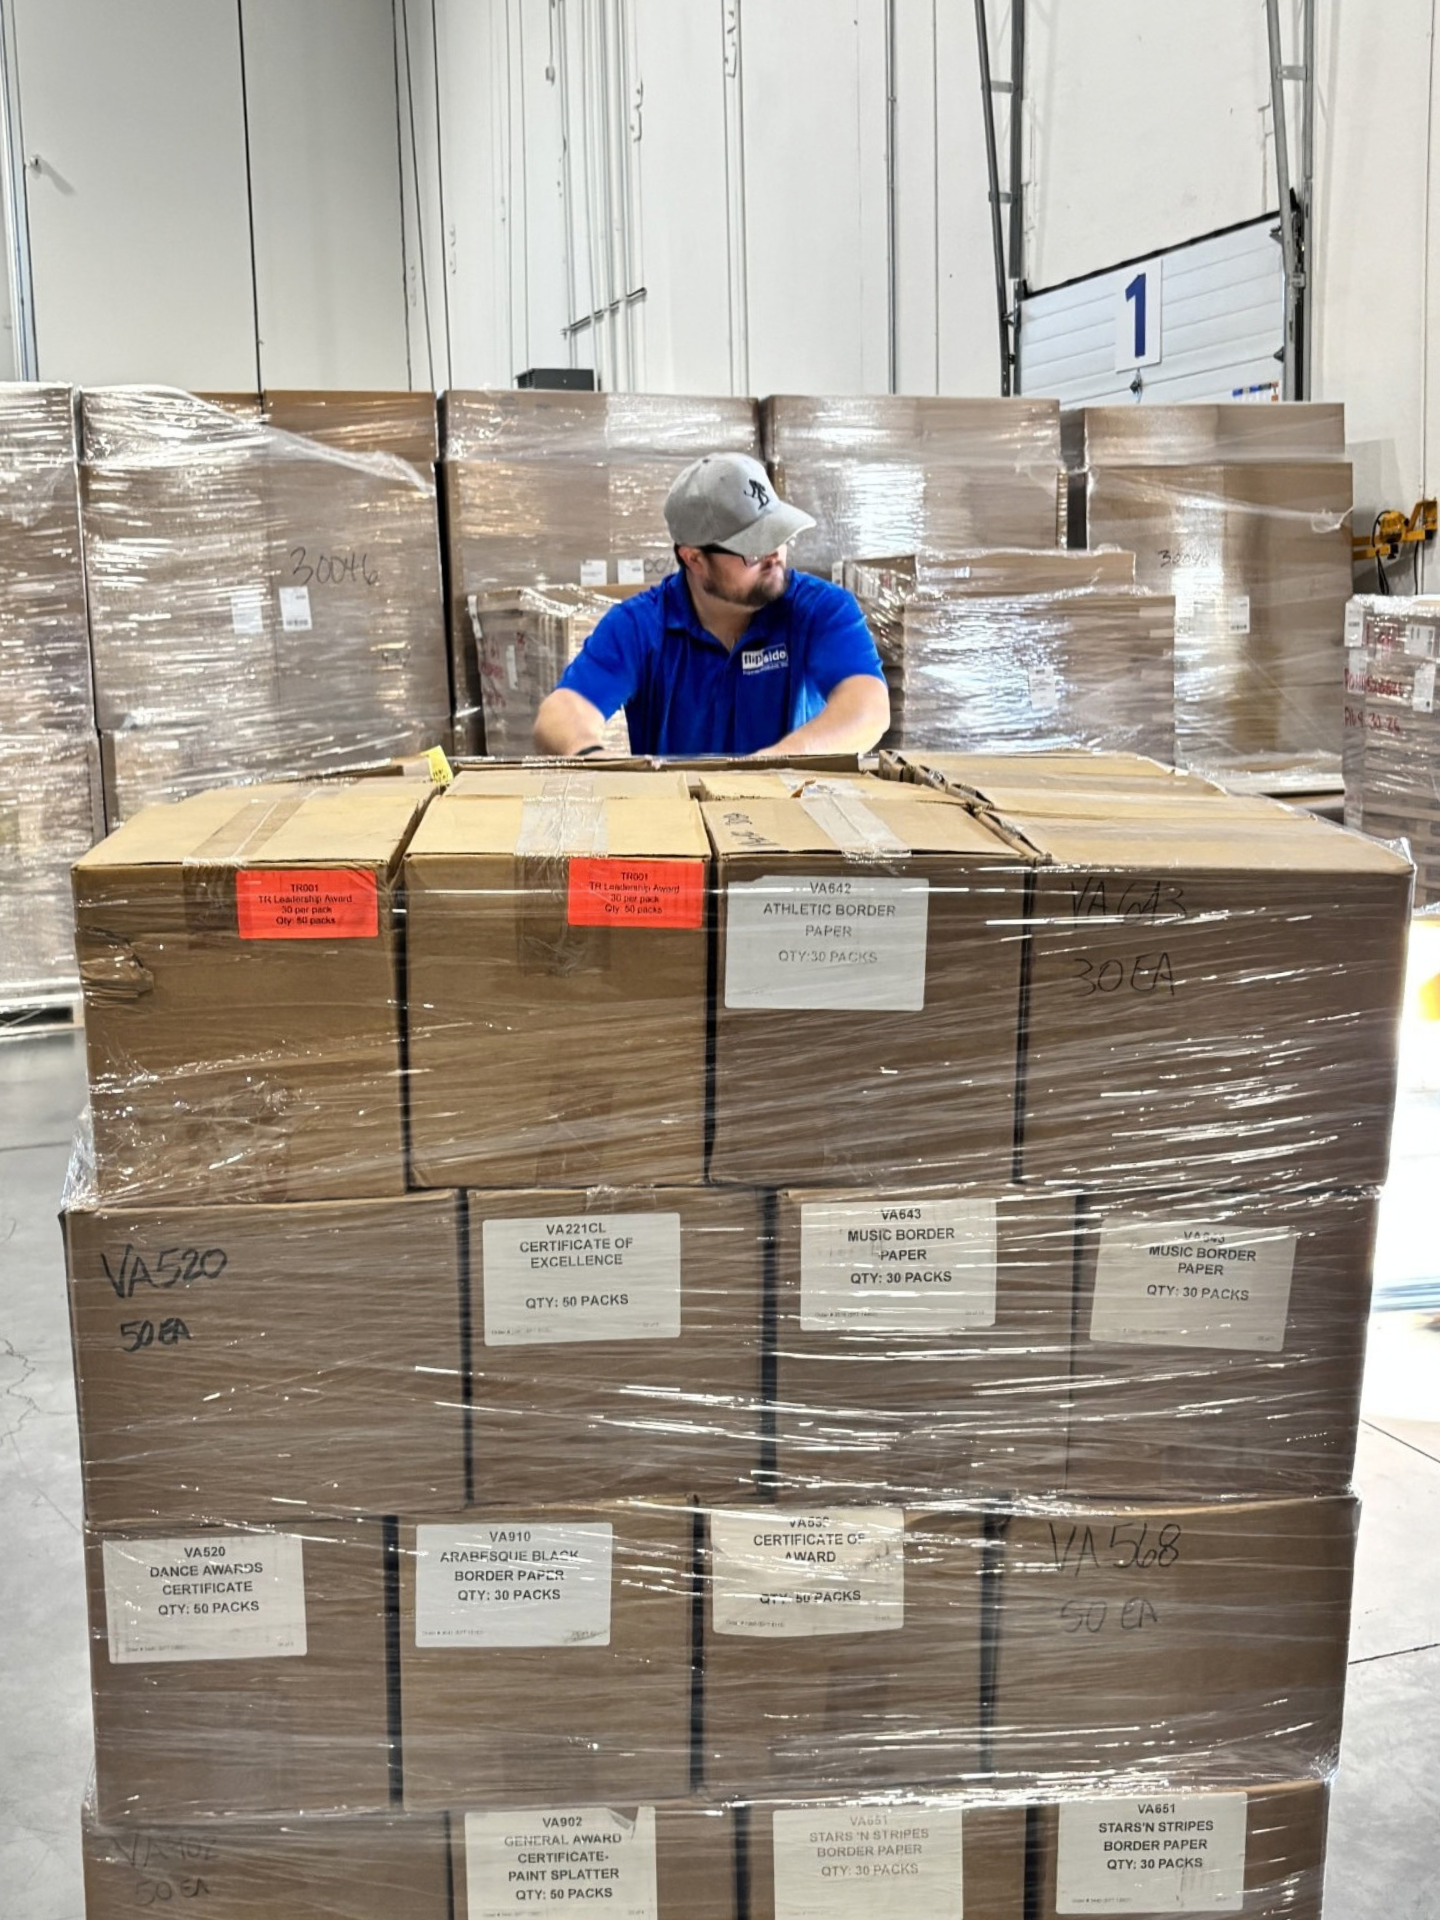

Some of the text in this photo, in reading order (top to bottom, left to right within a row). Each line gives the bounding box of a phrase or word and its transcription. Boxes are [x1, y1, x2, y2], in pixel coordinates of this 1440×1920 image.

[1124, 273, 1147, 359] 1
[290, 546, 379, 587] 30046
[620, 871, 649, 881] TR001
[290, 883, 319, 893] TR001
[588, 881, 680, 894] TR Leadership Award
[809, 881, 852, 895] VA642
[258, 894, 353, 905] TR Leadership Award
[610, 894, 660, 904] 30 per pack
[294, 906, 309, 915] per
[311, 905, 332, 915] pack
[637, 904, 663, 914] packs
[763, 903, 897, 917] ATHLETIC BORDER
[309, 916, 336, 926] packs
[805, 924, 852, 937] PAPER
[829, 950, 878, 963] PACKS
[881, 1208, 922, 1221] VA643
[546, 1222, 606, 1236] VA221CL
[847, 1227, 955, 1242] MUSIC BORDER
[519, 1237, 634, 1253] CERTIFICATE OF
[880, 1249, 927, 1261] PAPER
[1148, 1246, 1257, 1262] MUSIC BORDER
[530, 1254, 623, 1269] EXCELLENCE
[100, 1243, 228, 1298] VA520
[1177, 1263, 1224, 1276] PAPER
[850, 1271, 953, 1285] QTY: 30 PACKS
[1146, 1284, 1250, 1301] QTY: 30 PACKS
[525, 1293, 629, 1310] QTY: 50 PACKS
[120, 1319, 154, 1353] 50
[489, 1530, 532, 1543] VA910
[753, 1533, 843, 1547] CERTIFICATE
[183, 1546, 227, 1558] VA520
[440, 1549, 579, 1563] ARABESQUE BLACK
[785, 1551, 837, 1563] AWARD
[149, 1562, 264, 1578] DANCE AWARDS
[454, 1569, 565, 1582] BORDER PAPER
[162, 1581, 253, 1596] CERTIFICATE
[457, 1588, 561, 1602] QTY: 30 PACKS
[759, 1590, 862, 1605] QTY 50 PACKS
[158, 1600, 260, 1616] QTY: 50 PACKS
[1137, 1803, 1176, 1815] VA651
[542, 1816, 583, 1828] VA902
[849, 1815, 889, 1827] VA651
[1158, 1820, 1214, 1832] STRIPES
[504, 1832, 622, 1847] GENERAL AWARD
[809, 1831, 853, 1843] STARS
[872, 1828, 930, 1840] STRIPES
[816, 1844, 923, 1858] BORDER PAPER
[1103, 1838, 1208, 1852] BORDER PAPER
[517, 1850, 610, 1864] CERTIFICATE-
[1106, 1857, 1203, 1870] QTY: 30 PACKS
[508, 1867, 620, 1882] PAINT SPLATTER
[821, 1863, 919, 1877] QTY: 30 PACKS
[515, 1887, 613, 1901] QTY: 50 PACKS
